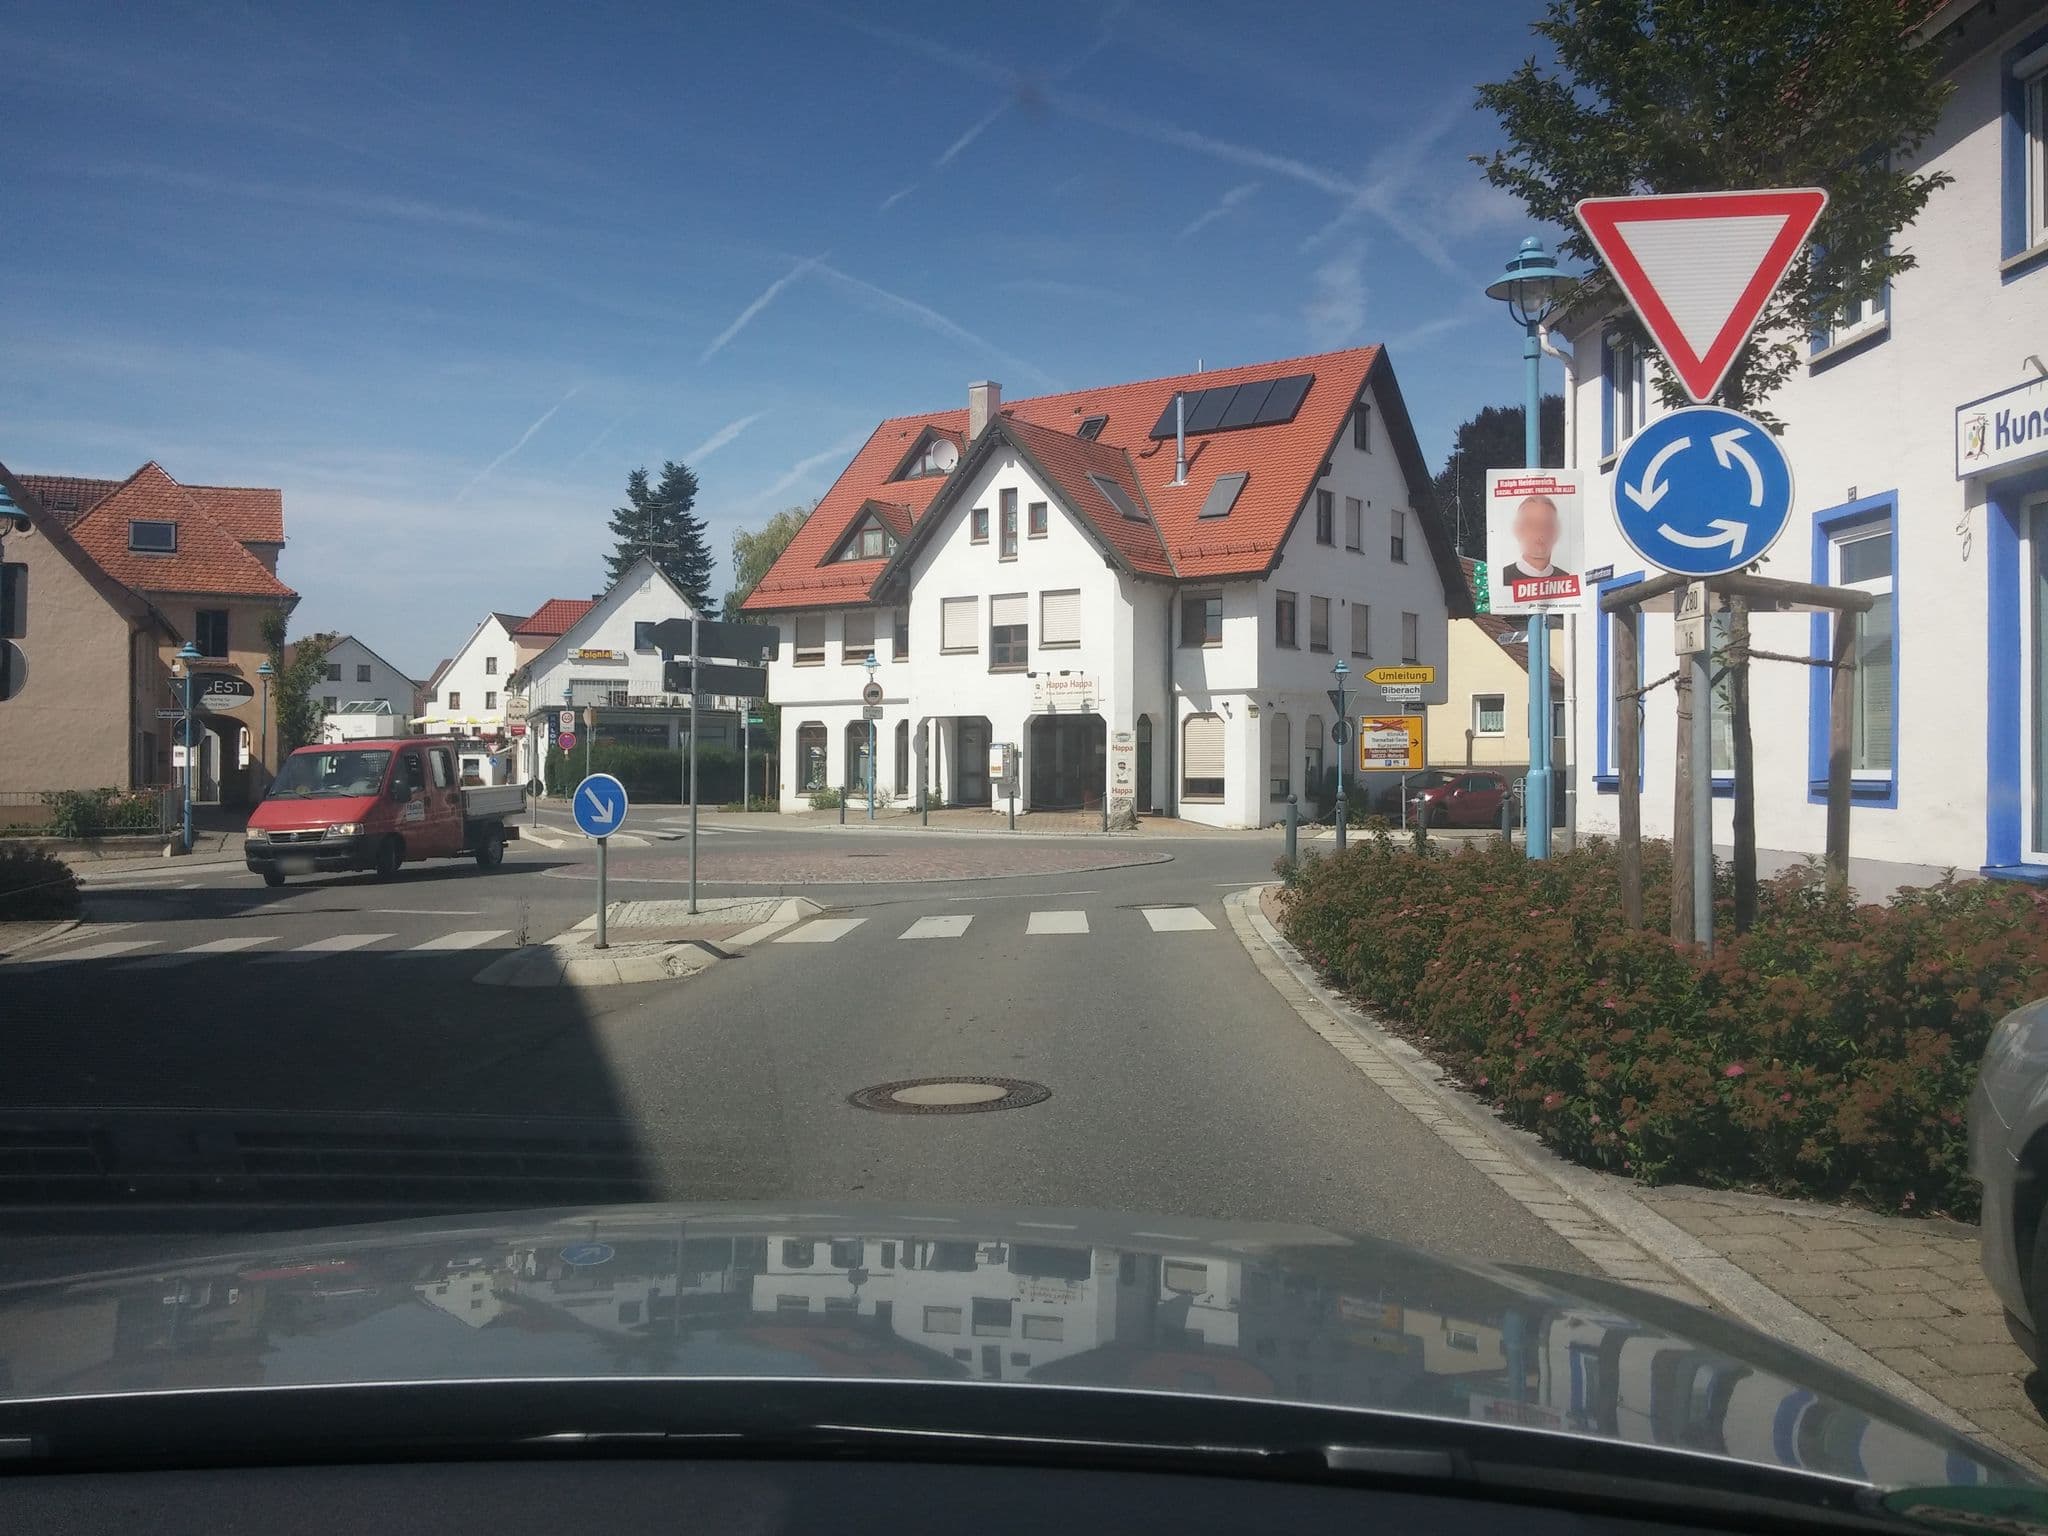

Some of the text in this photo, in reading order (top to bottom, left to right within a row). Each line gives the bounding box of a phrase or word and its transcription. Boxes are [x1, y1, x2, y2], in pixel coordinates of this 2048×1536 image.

[1517, 583, 1538, 598] DIE
[1378, 671, 1427, 682] Umleitung
[1046, 679, 1092, 690] Happa Happa
[1382, 686, 1420, 694] Biberach
[1112, 744, 1133, 752] Happa
[1111, 787, 1133, 795] Happa
